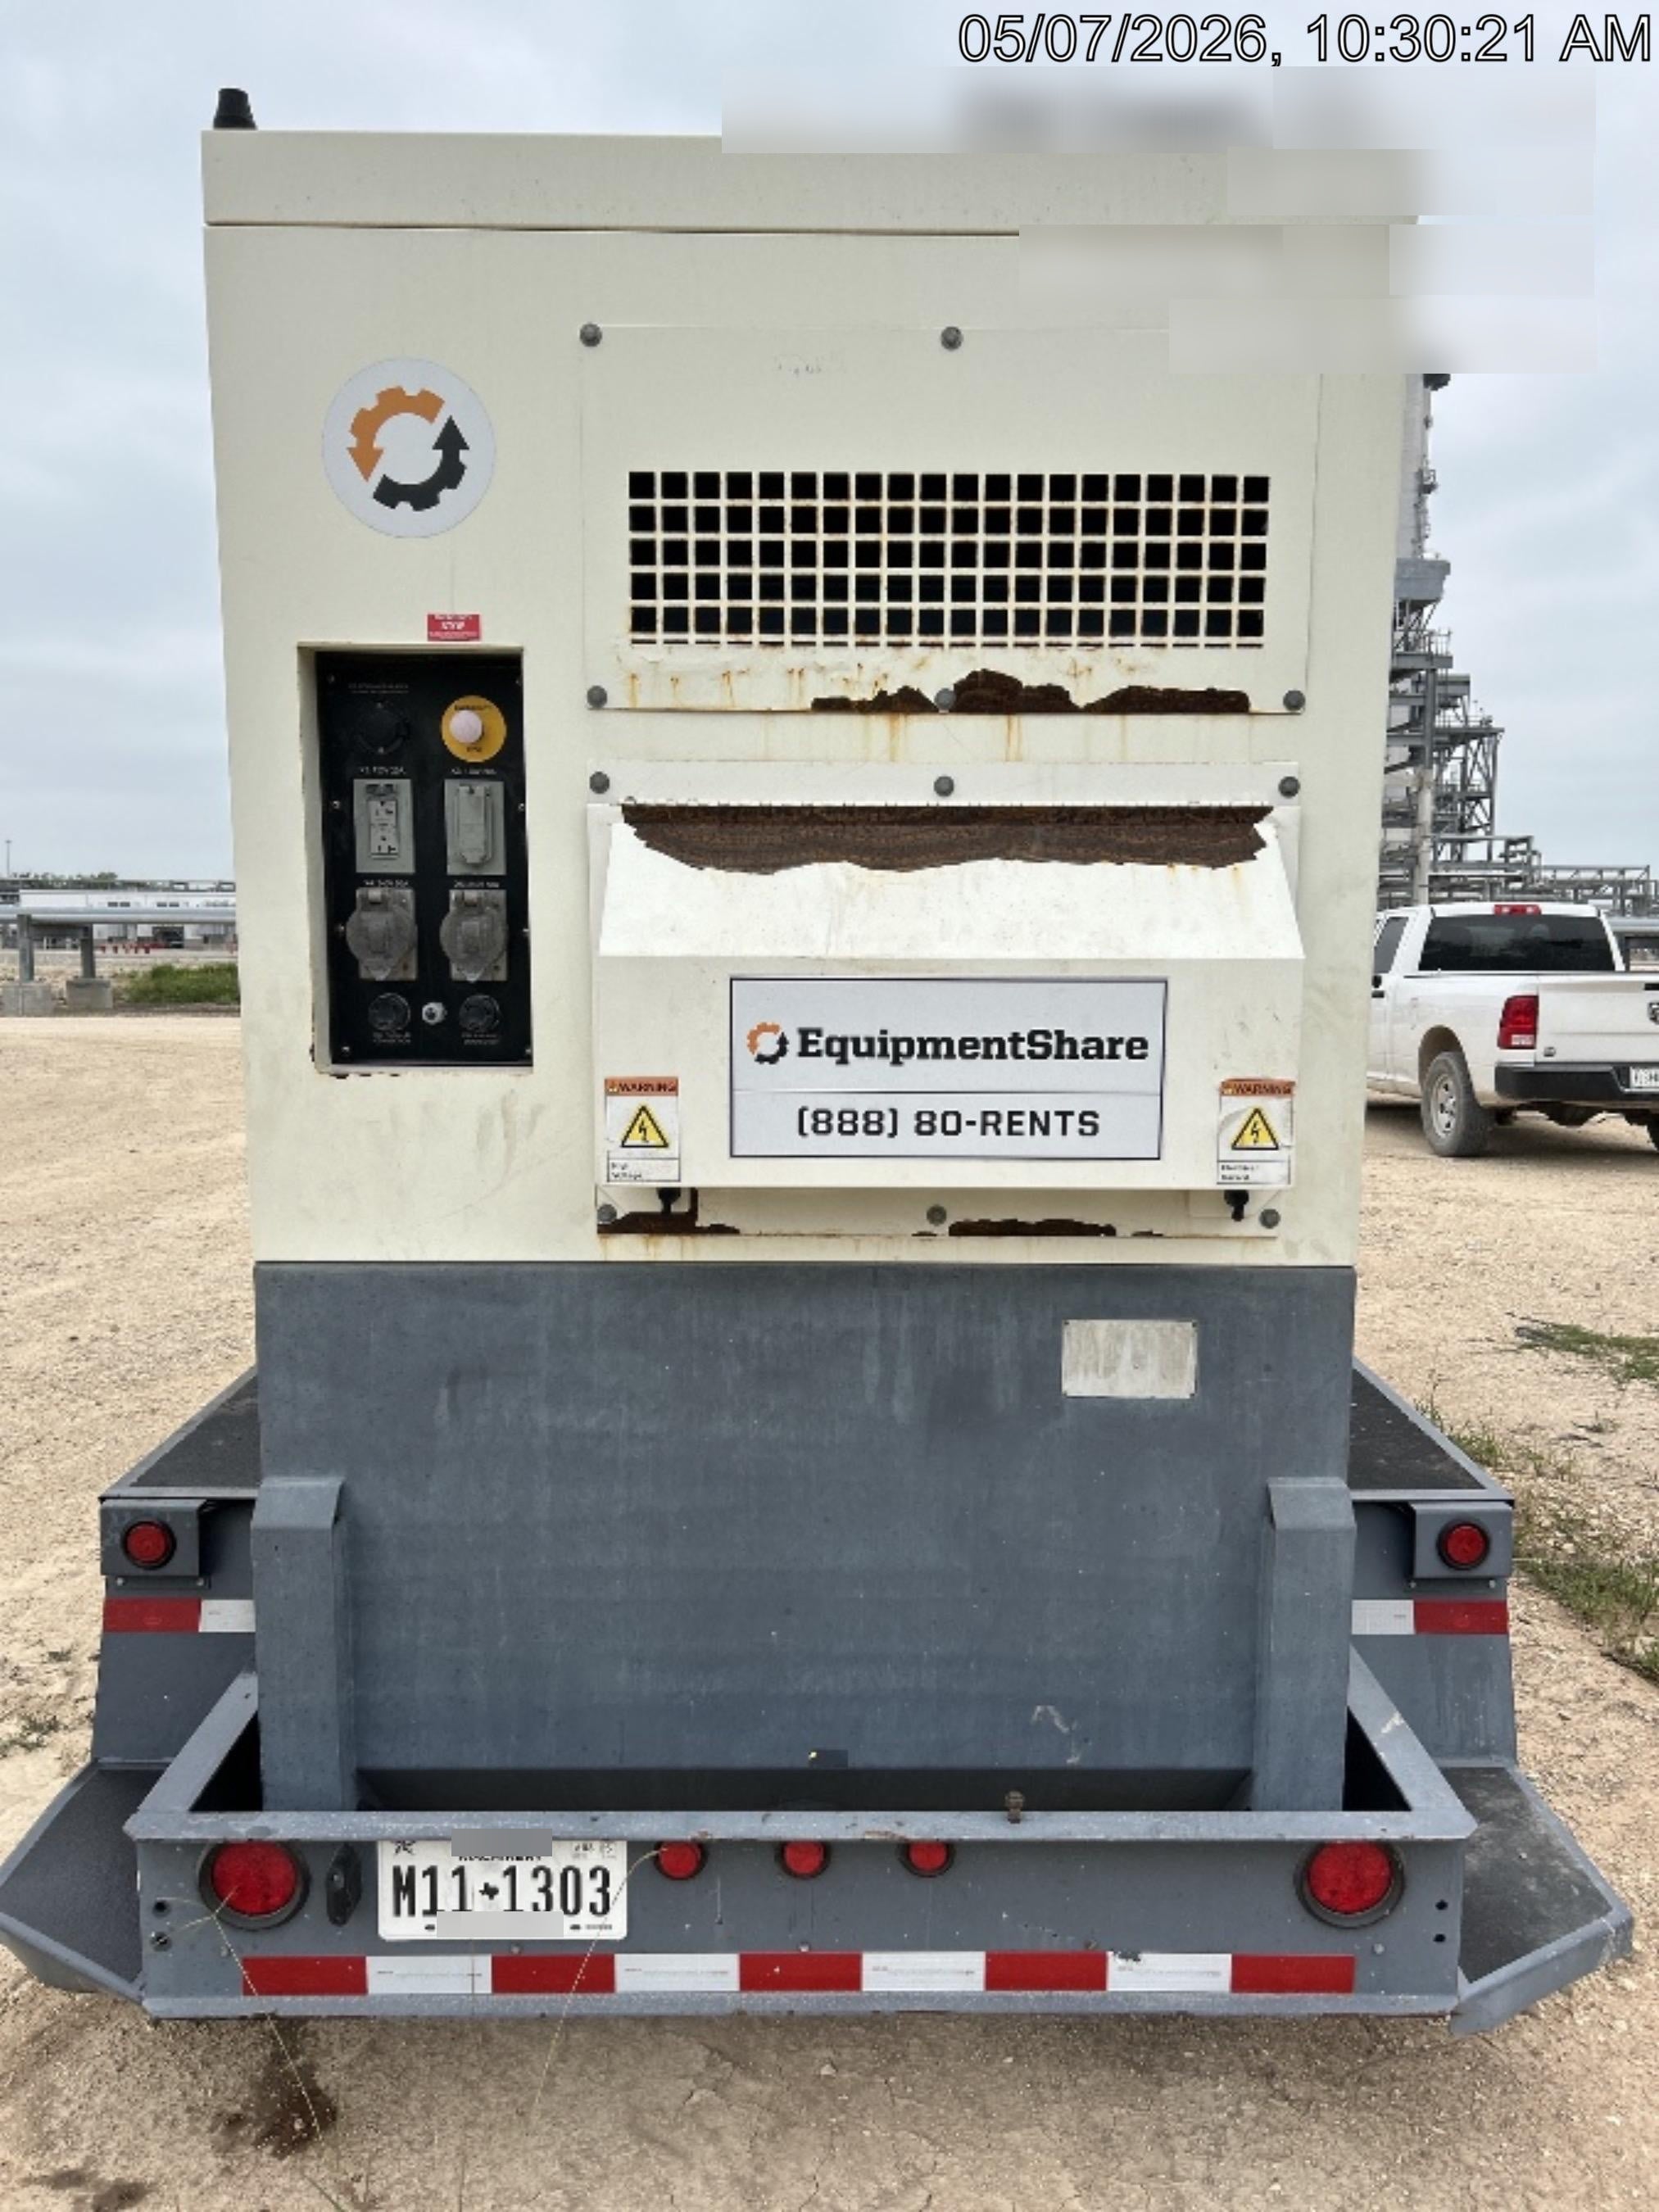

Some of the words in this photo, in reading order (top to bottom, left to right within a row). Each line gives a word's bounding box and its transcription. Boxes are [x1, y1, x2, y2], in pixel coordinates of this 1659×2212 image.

[797, 1027, 1149, 1066] EquipmentShare
[619, 1081, 677, 1093] WARNING
[1235, 1081, 1292, 1095] WARNING
[797, 1105, 899, 1140] (888)
[914, 1106, 1100, 1138] 80-RENTS
